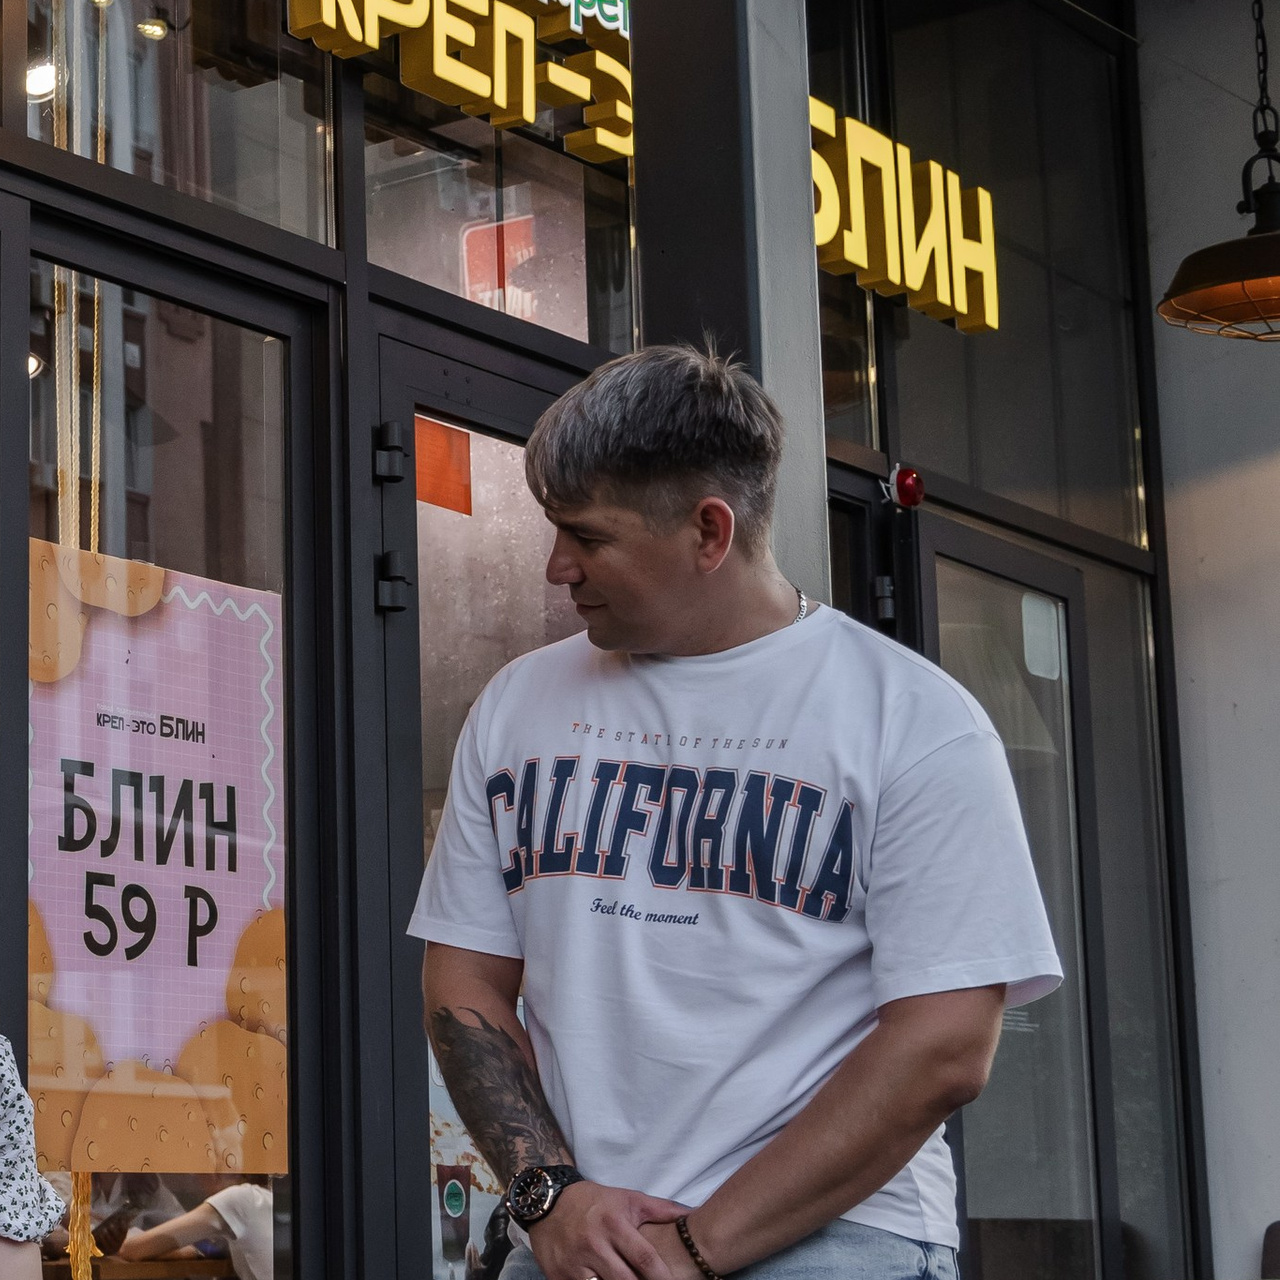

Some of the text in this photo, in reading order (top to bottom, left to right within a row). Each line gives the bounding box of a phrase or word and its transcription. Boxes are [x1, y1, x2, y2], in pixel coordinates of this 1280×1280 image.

[160, 715, 205, 744] БЛИН
[571, 722, 606, 739] THE
[679, 735, 702, 749] OF
[711, 737, 745, 750] THE
[752, 737, 788, 750] SUN
[57, 758, 237, 872] БЛИН
[485, 755, 855, 924] CALIFORNIA
[82, 870, 158, 962] 59
[590, 898, 700, 925] Feel the moment
